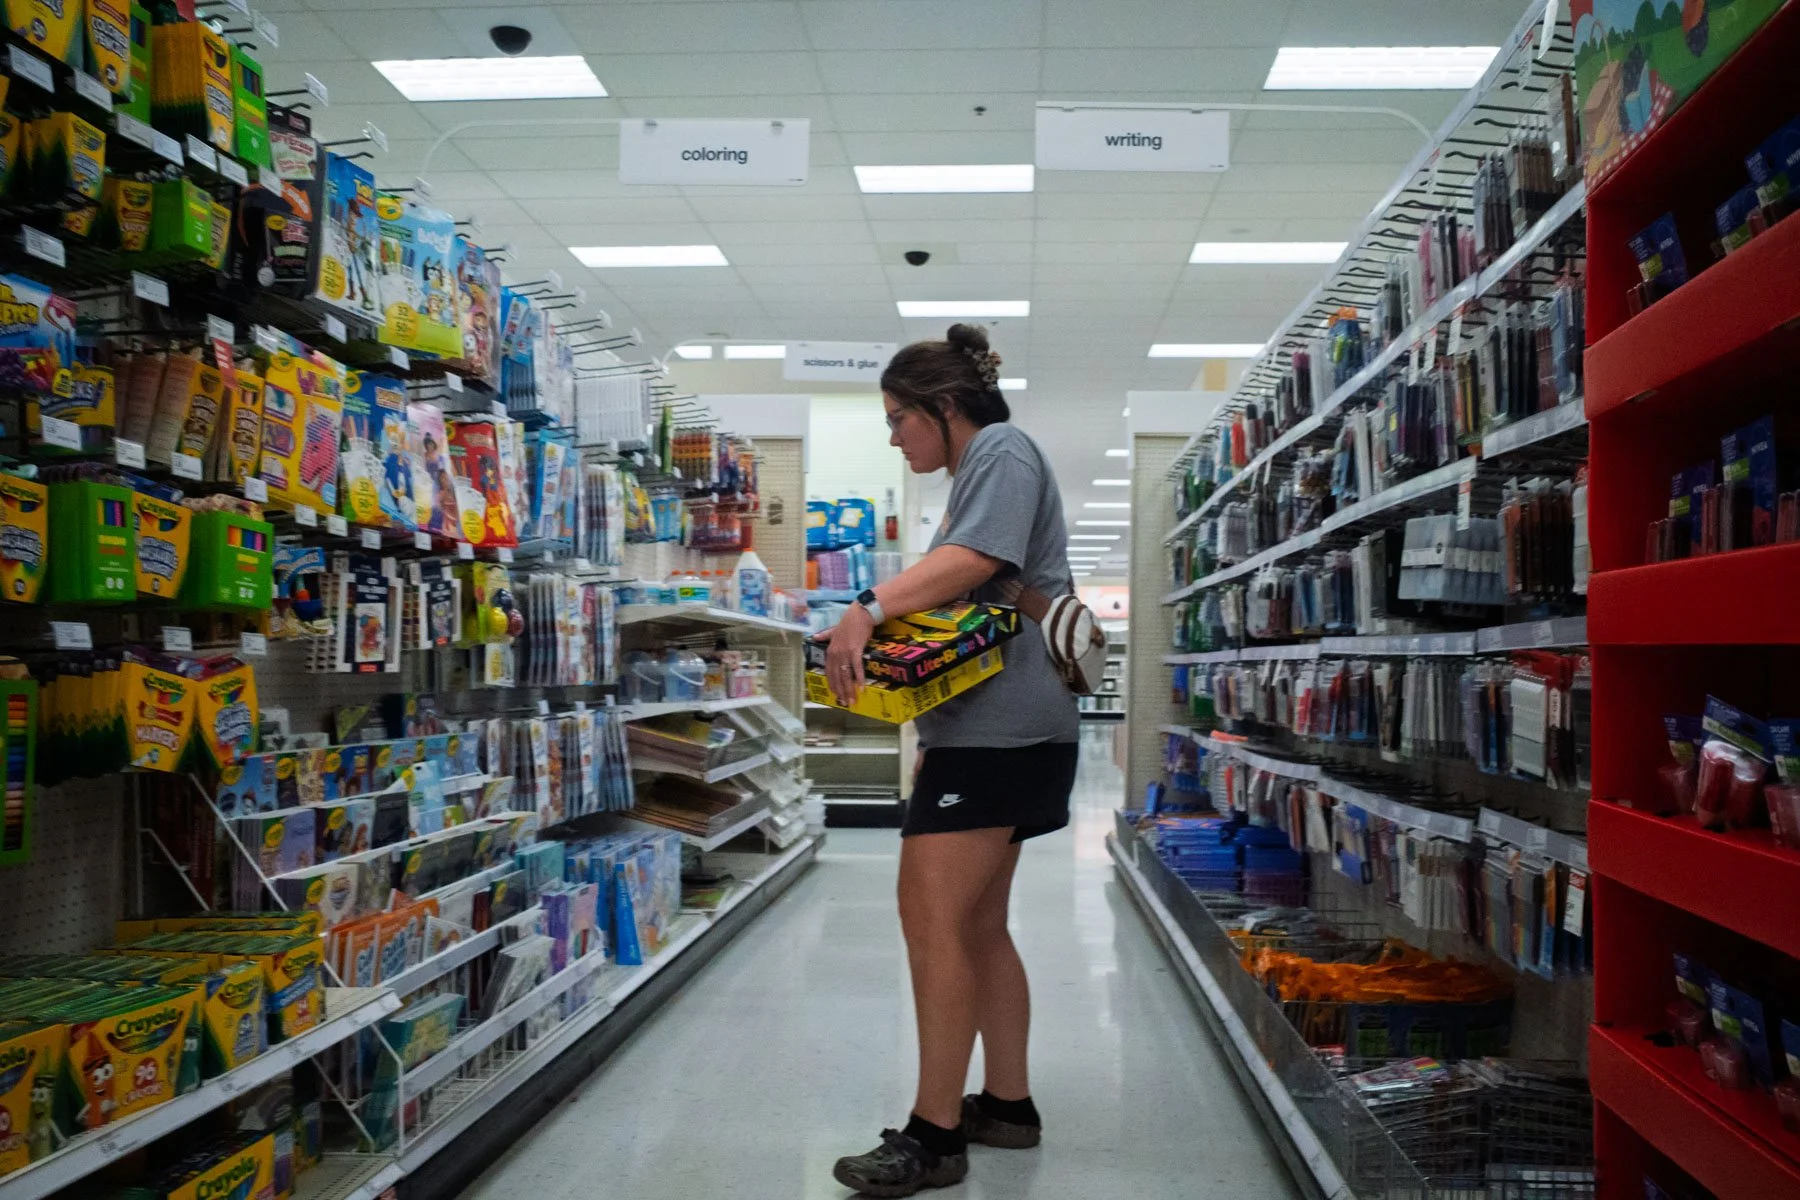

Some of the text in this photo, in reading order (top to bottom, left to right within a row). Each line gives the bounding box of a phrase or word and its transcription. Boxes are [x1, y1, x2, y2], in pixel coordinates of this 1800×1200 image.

[1105, 131, 1163, 151] writing
[681, 146, 748, 165] coloring
[803, 358, 879, 370] scissors & glue
[145, 672, 183, 692] Crayola
[114, 1006, 178, 1038] Crayola
[196, 1156, 256, 1200] Crayola
